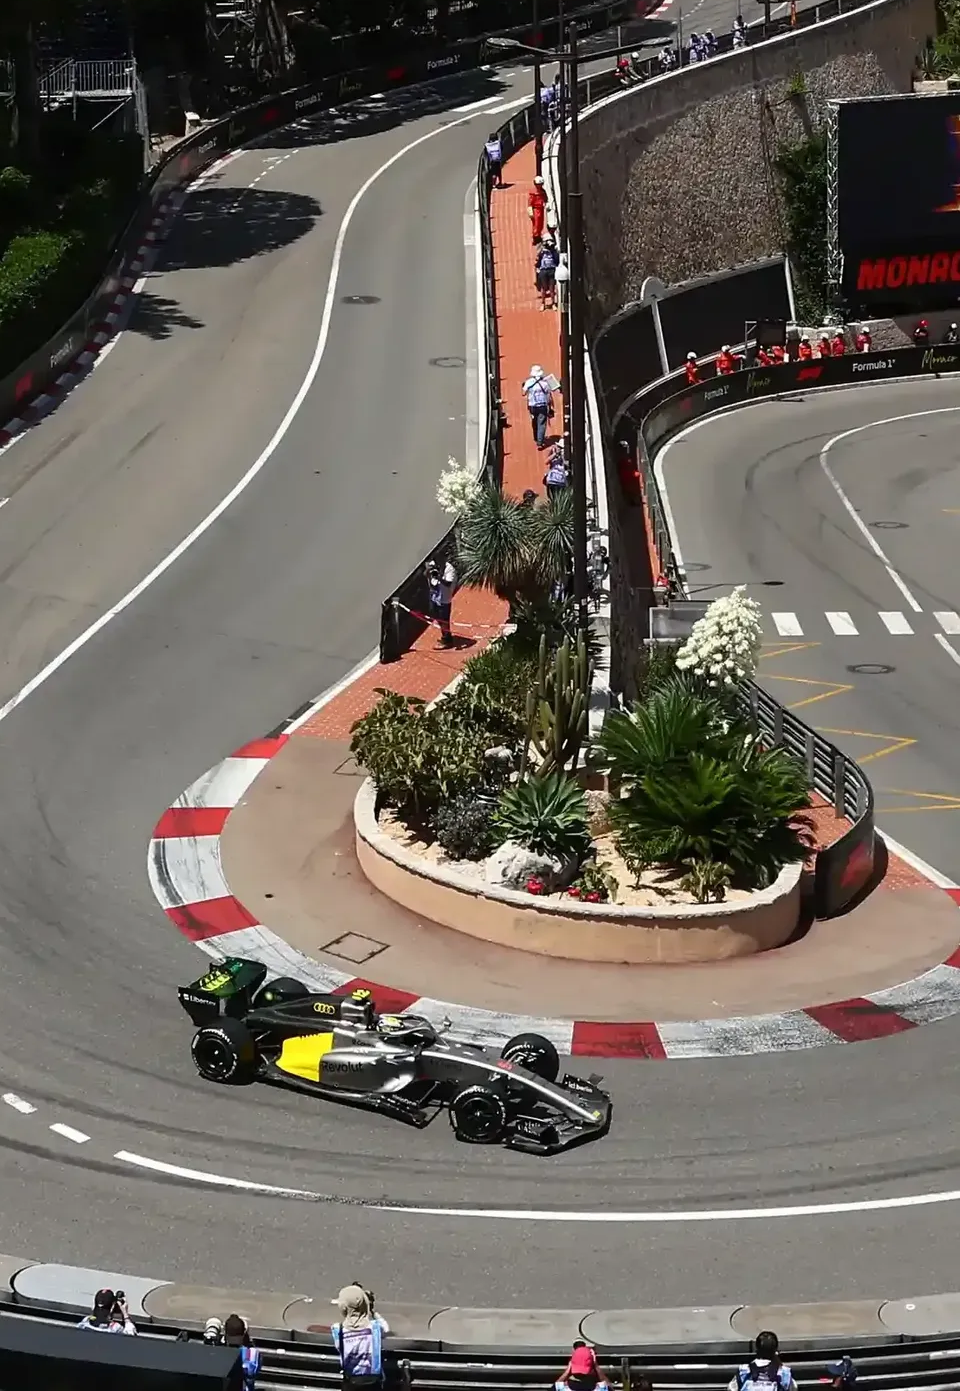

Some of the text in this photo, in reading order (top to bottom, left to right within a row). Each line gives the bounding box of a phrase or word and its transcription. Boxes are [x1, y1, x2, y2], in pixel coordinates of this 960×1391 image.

[922, 348, 957, 370] Monaco
[852, 361, 887, 372] Formula
[321, 1061, 363, 1073] Revolut
